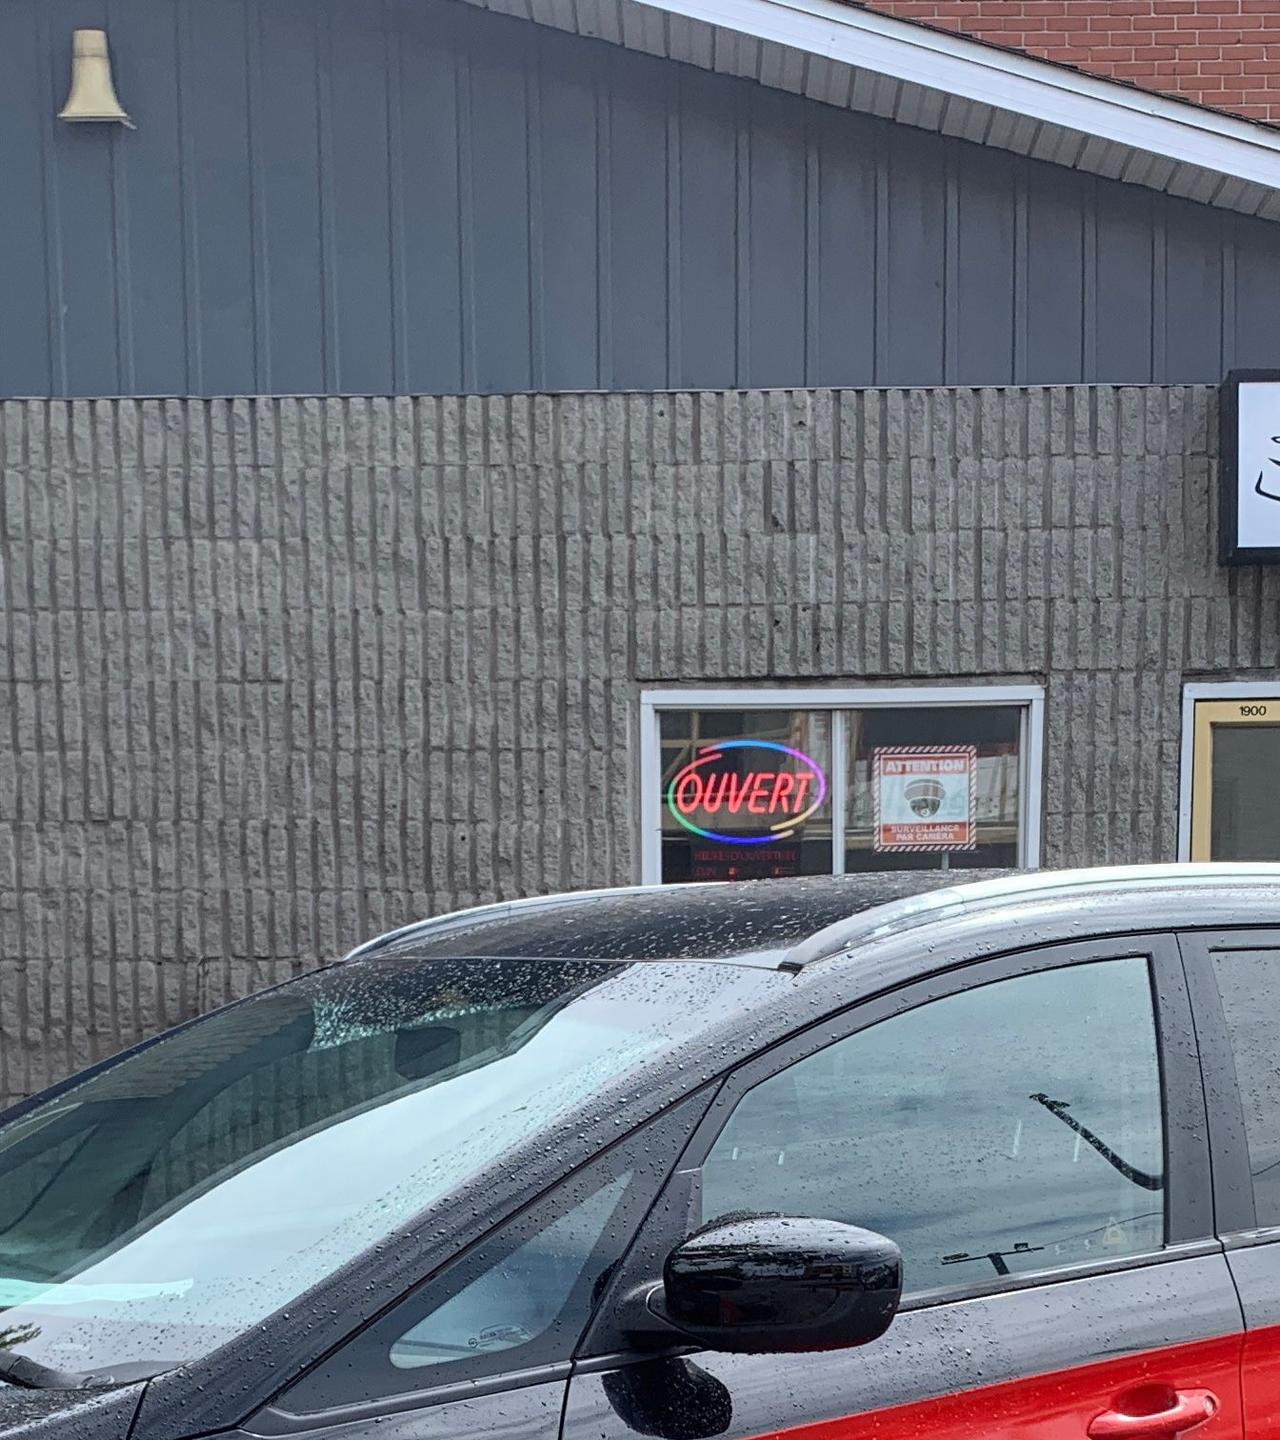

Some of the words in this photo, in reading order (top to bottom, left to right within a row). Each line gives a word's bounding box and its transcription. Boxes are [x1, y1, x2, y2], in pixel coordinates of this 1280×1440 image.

[1239, 705, 1267, 717] 1900
[885, 759, 964, 773] ATTENTION
[676, 772, 815, 814] OUVERT
[891, 824, 960, 833] SURVEILLANCE
[895, 832, 914, 841] PAR
